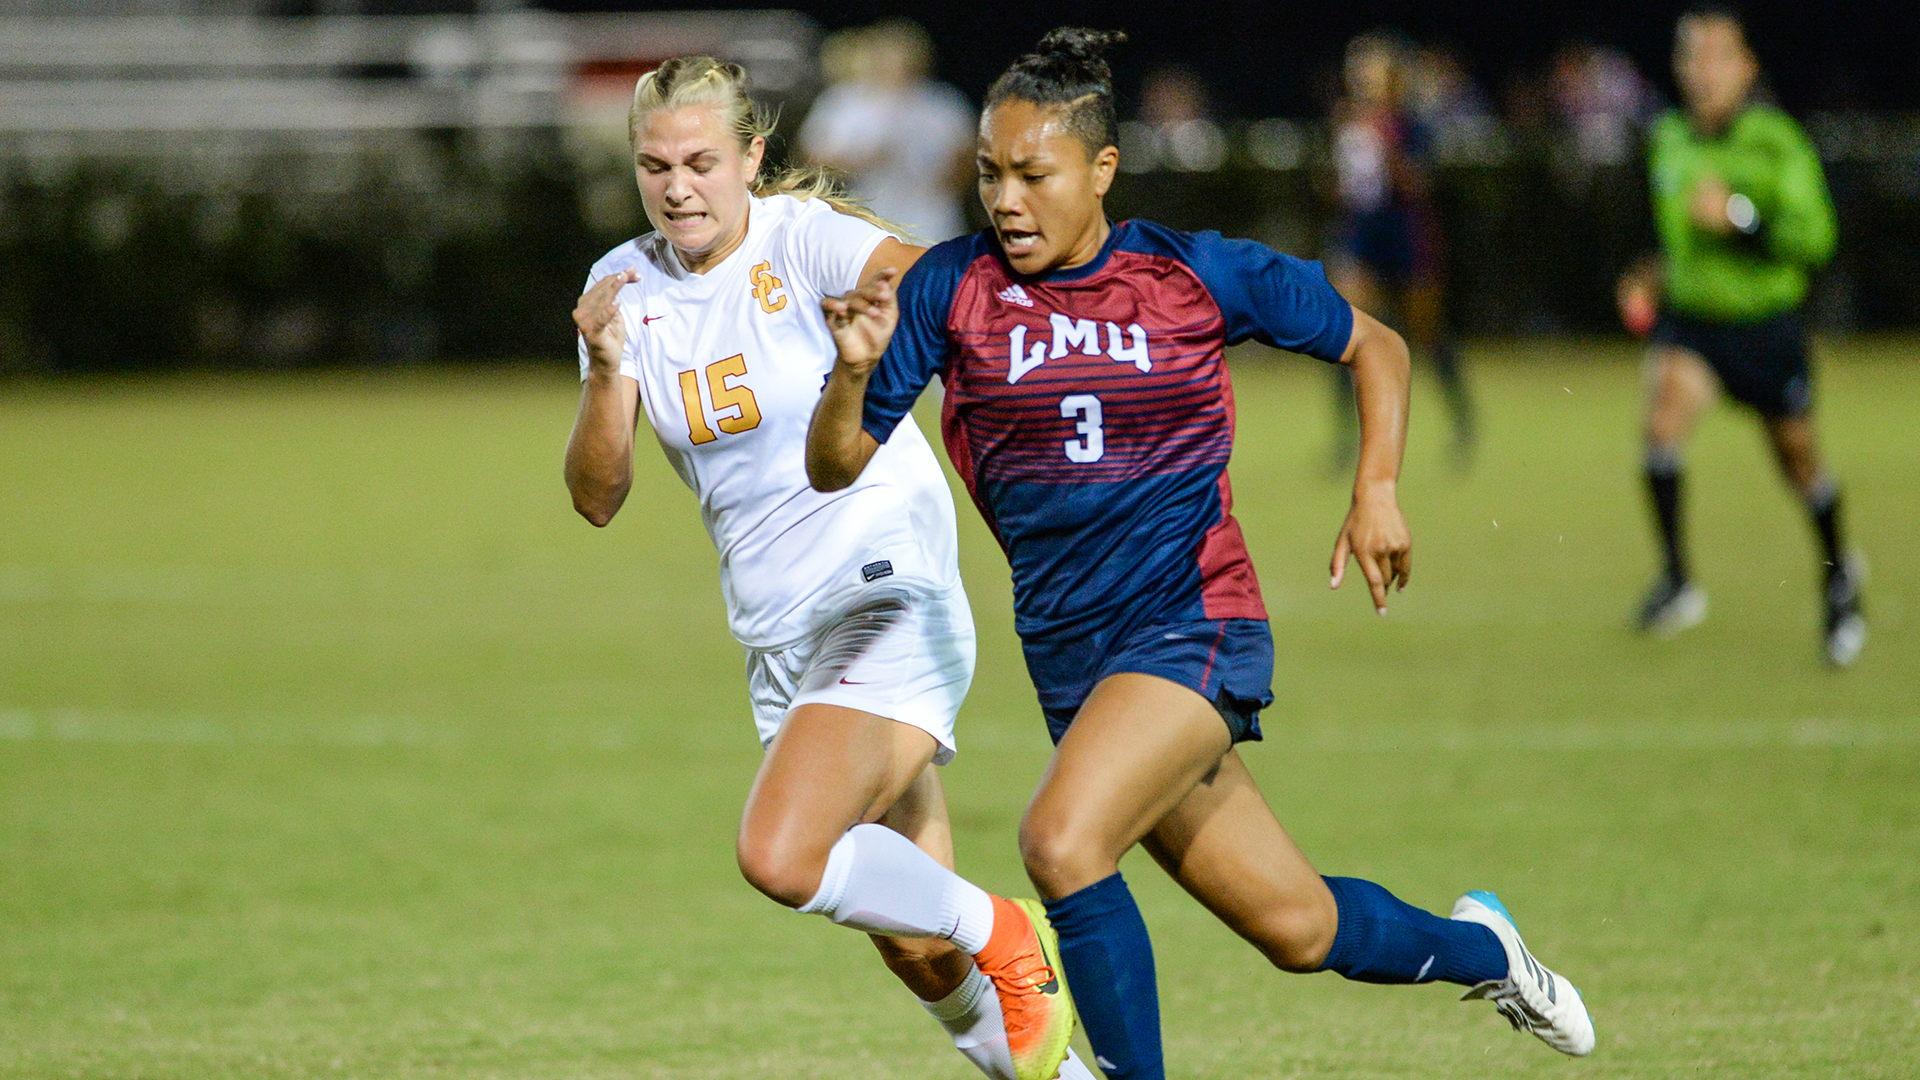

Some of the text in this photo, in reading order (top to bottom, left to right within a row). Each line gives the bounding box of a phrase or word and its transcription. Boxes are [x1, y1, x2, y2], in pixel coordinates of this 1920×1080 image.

[750, 259, 787, 314] SC
[1007, 312, 1152, 384] LMU
[678, 353, 762, 445] 15
[1060, 394, 1104, 463] 3
